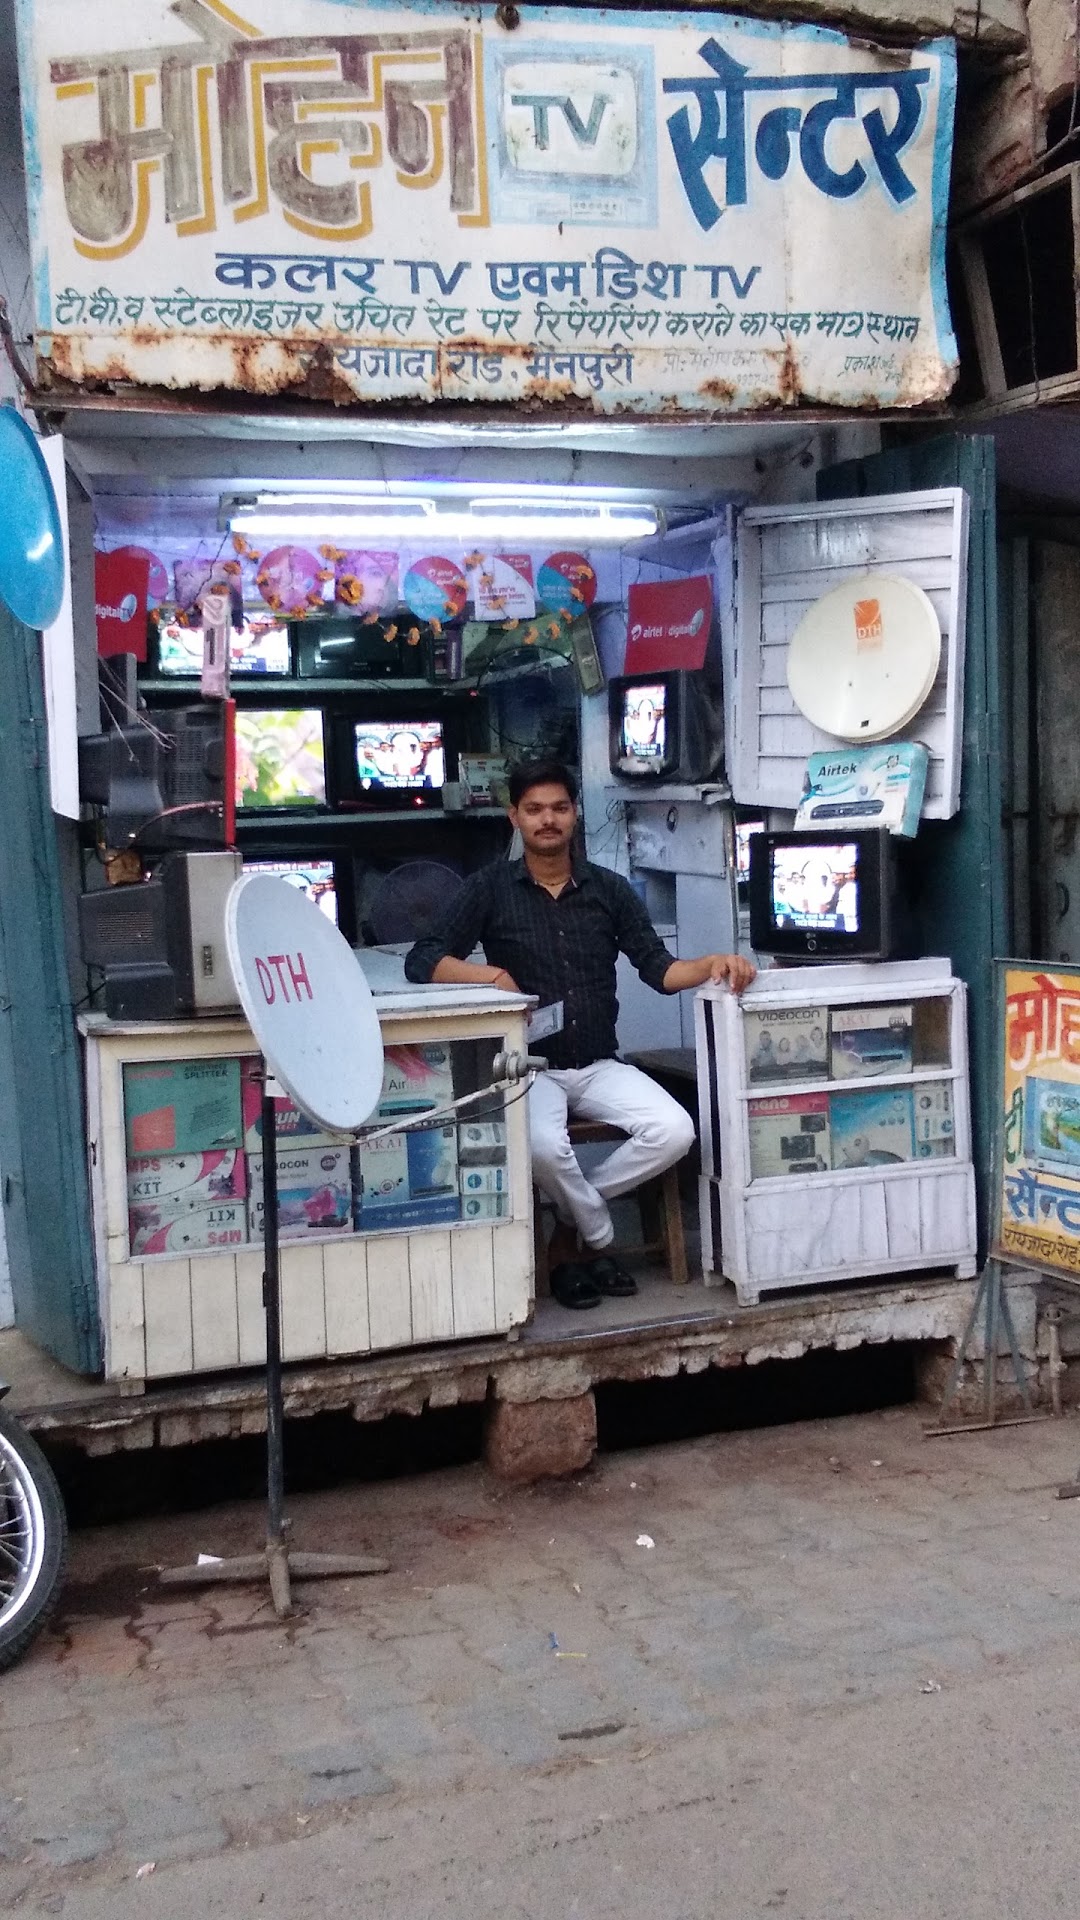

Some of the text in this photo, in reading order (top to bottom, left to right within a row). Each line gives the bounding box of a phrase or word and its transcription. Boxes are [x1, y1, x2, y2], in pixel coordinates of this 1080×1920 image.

[49, 0, 930, 258] मोहन TV सेन्टर
[215, 246, 762, 301] कलर TV एवम डिश TV
[332, 295, 417, 337] उचित
[423, 297, 468, 338] रेट
[477, 307, 522, 342] पर
[664, 302, 736, 342] कराते
[643, 626, 663, 639] airtel
[856, 624, 882, 640] DTH
[817, 762, 858, 778] Airtek
[255, 952, 314, 1005] DTH
[275, 1111, 301, 1125] UN
[132, 1181, 163, 1195] KIT
[206, 1208, 236, 1223] KIT
